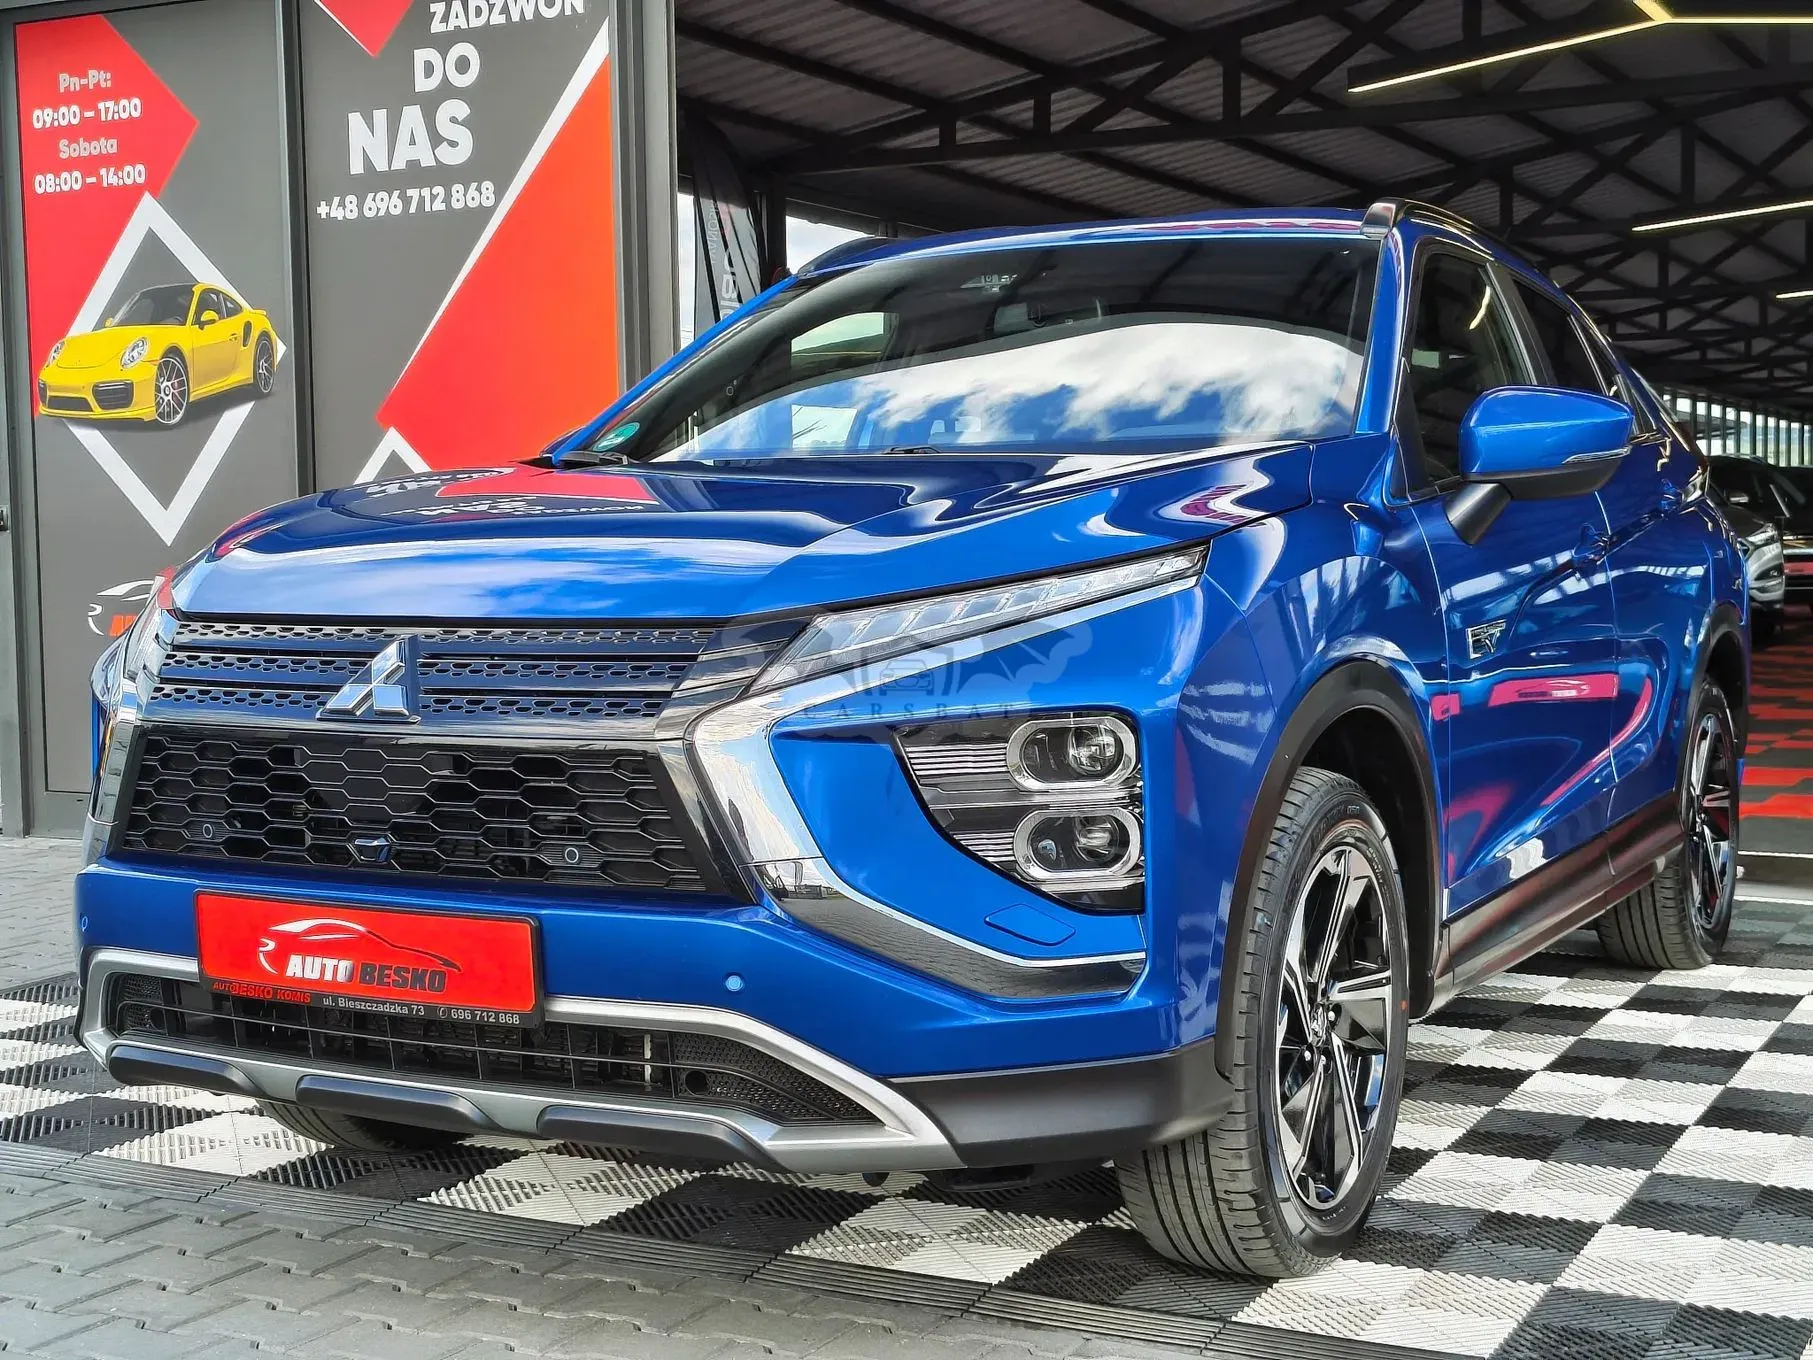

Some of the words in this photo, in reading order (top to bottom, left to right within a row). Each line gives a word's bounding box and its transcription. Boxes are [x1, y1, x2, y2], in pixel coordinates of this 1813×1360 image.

[59, 69, 111, 93] Pn-Pt:
[413, 42, 481, 93] DO
[32, 104, 81, 129] 09:00
[97, 97, 142, 122] 17:00
[59, 137, 118, 159] Sobota
[347, 98, 474, 175] NAS
[34, 170, 83, 194] 08:00
[99, 163, 146, 187] 14:00
[316, 194, 359, 221] +48
[362, 189, 403, 218] 696
[406, 185, 447, 214] 712
[450, 180, 496, 210] 868
[285, 954, 354, 983] AUTO
[359, 961, 448, 993] BESKO
[277, 989, 311, 1004] KOMIS
[411, 1005, 425, 1016] 73
[451, 1008, 472, 1020] 696
[475, 1010, 496, 1022] 712
[499, 1012, 520, 1025] 868
